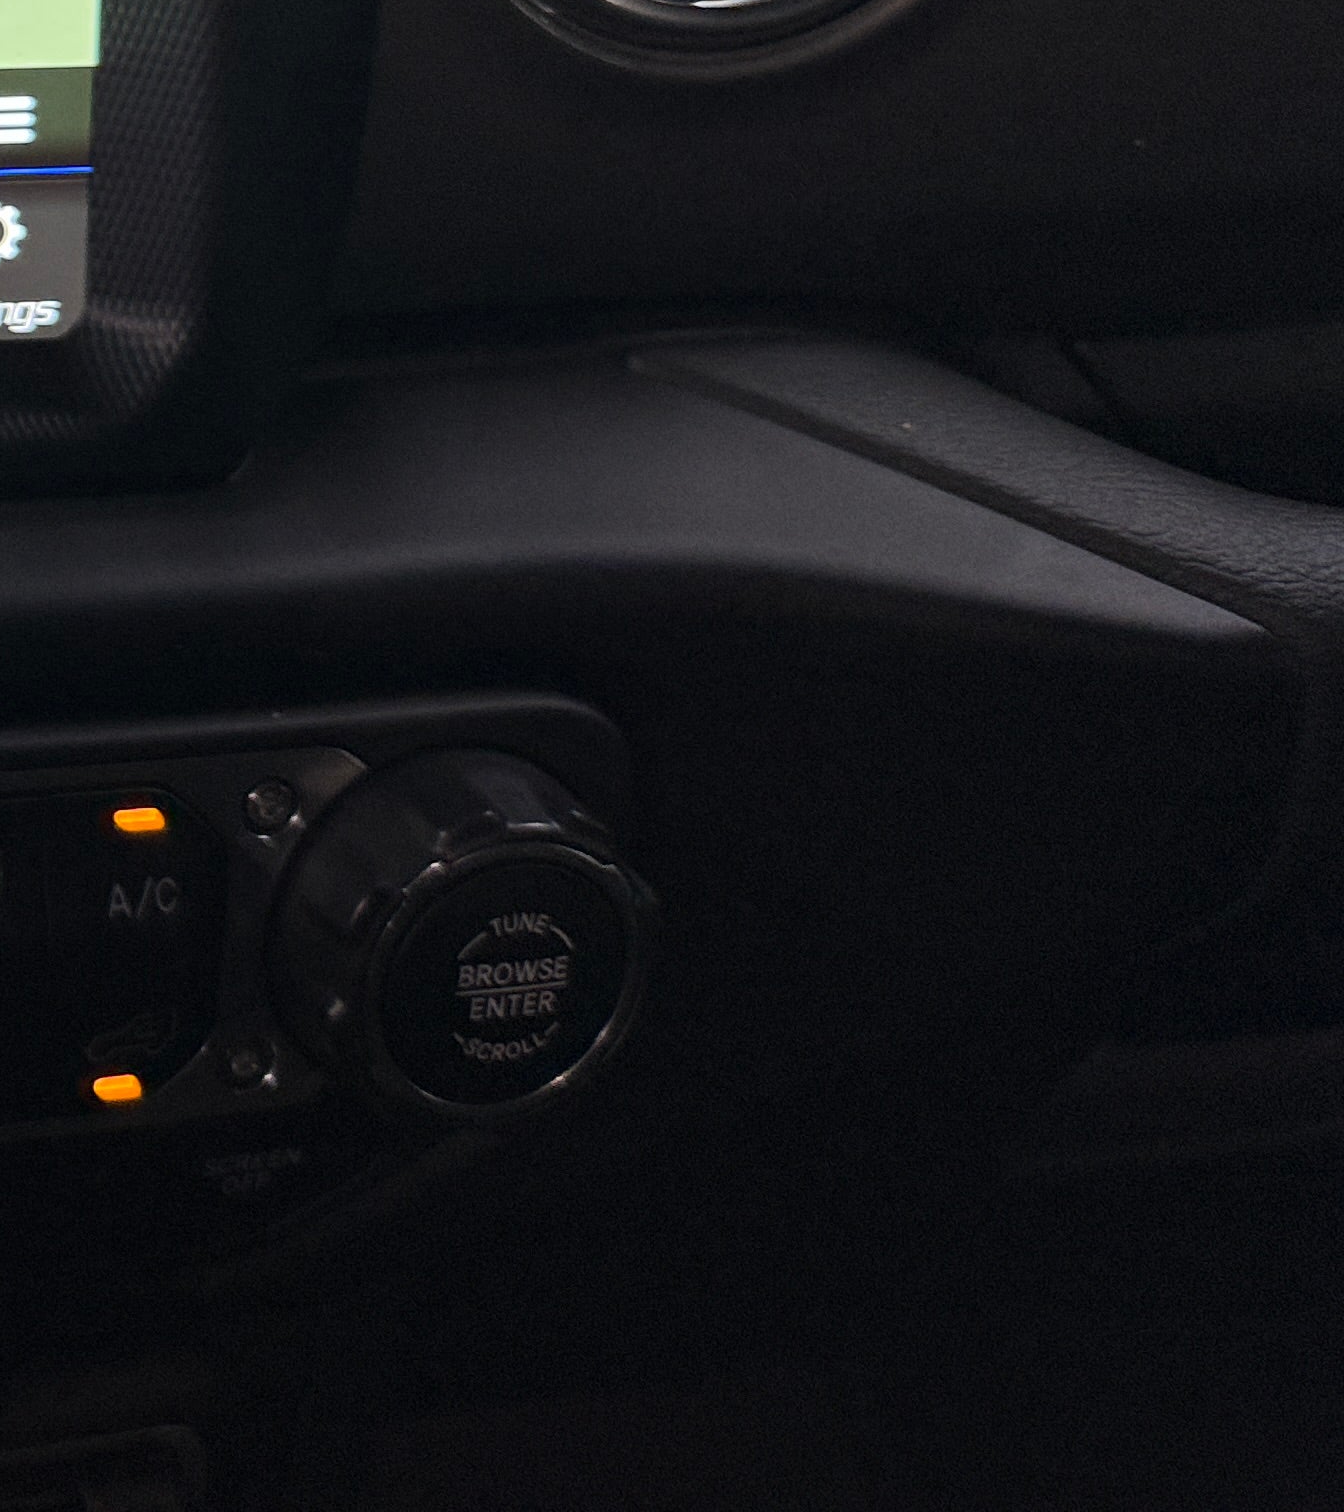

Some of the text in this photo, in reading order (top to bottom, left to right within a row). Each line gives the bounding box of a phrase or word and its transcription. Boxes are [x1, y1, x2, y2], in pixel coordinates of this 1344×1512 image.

[108, 876, 178, 919] A/C
[489, 912, 551, 937] TUNE
[458, 955, 569, 988] BROWSE
[469, 991, 557, 1021] ENTER
[464, 1031, 548, 1062] SCROLL
